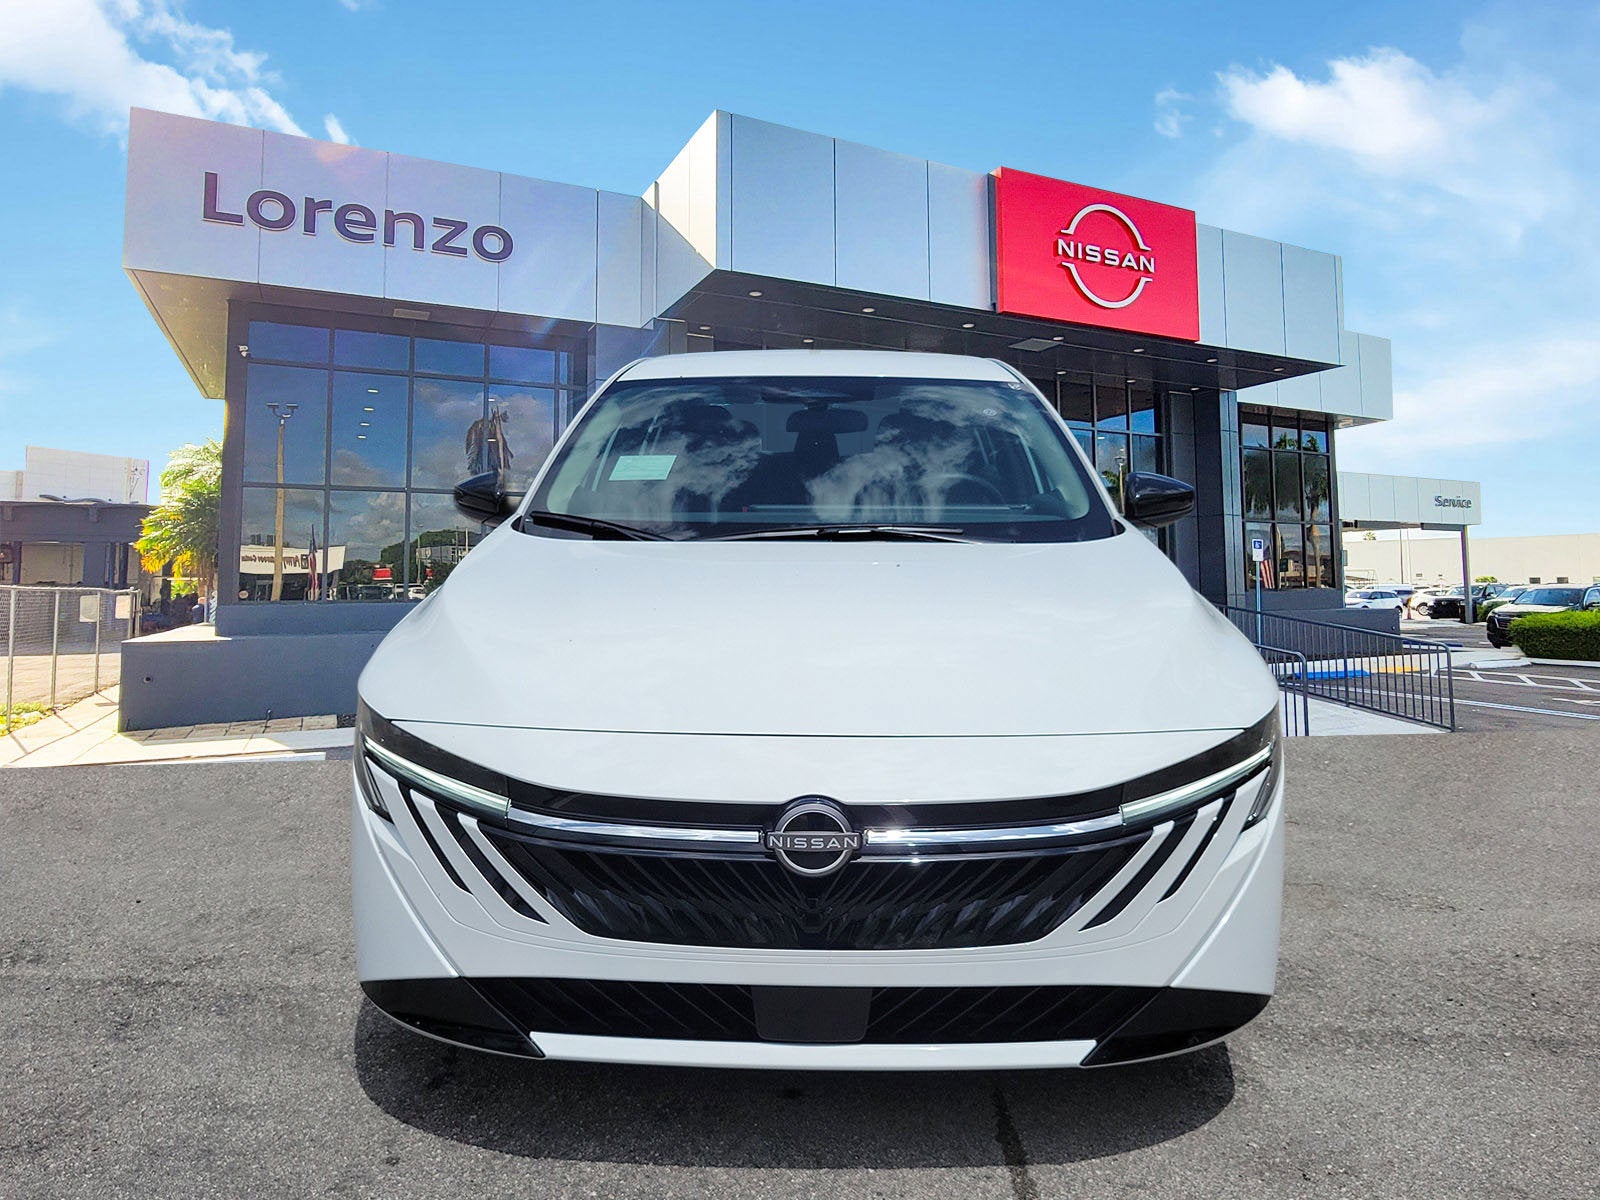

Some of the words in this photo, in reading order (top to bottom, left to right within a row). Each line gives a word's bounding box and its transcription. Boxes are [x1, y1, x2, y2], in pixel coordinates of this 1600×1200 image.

[202, 171, 514, 262] Lorenzo
[1057, 238, 1155, 273] NISSAN
[1434, 495, 1472, 508] Service
[769, 836, 858, 849] NISSAN
